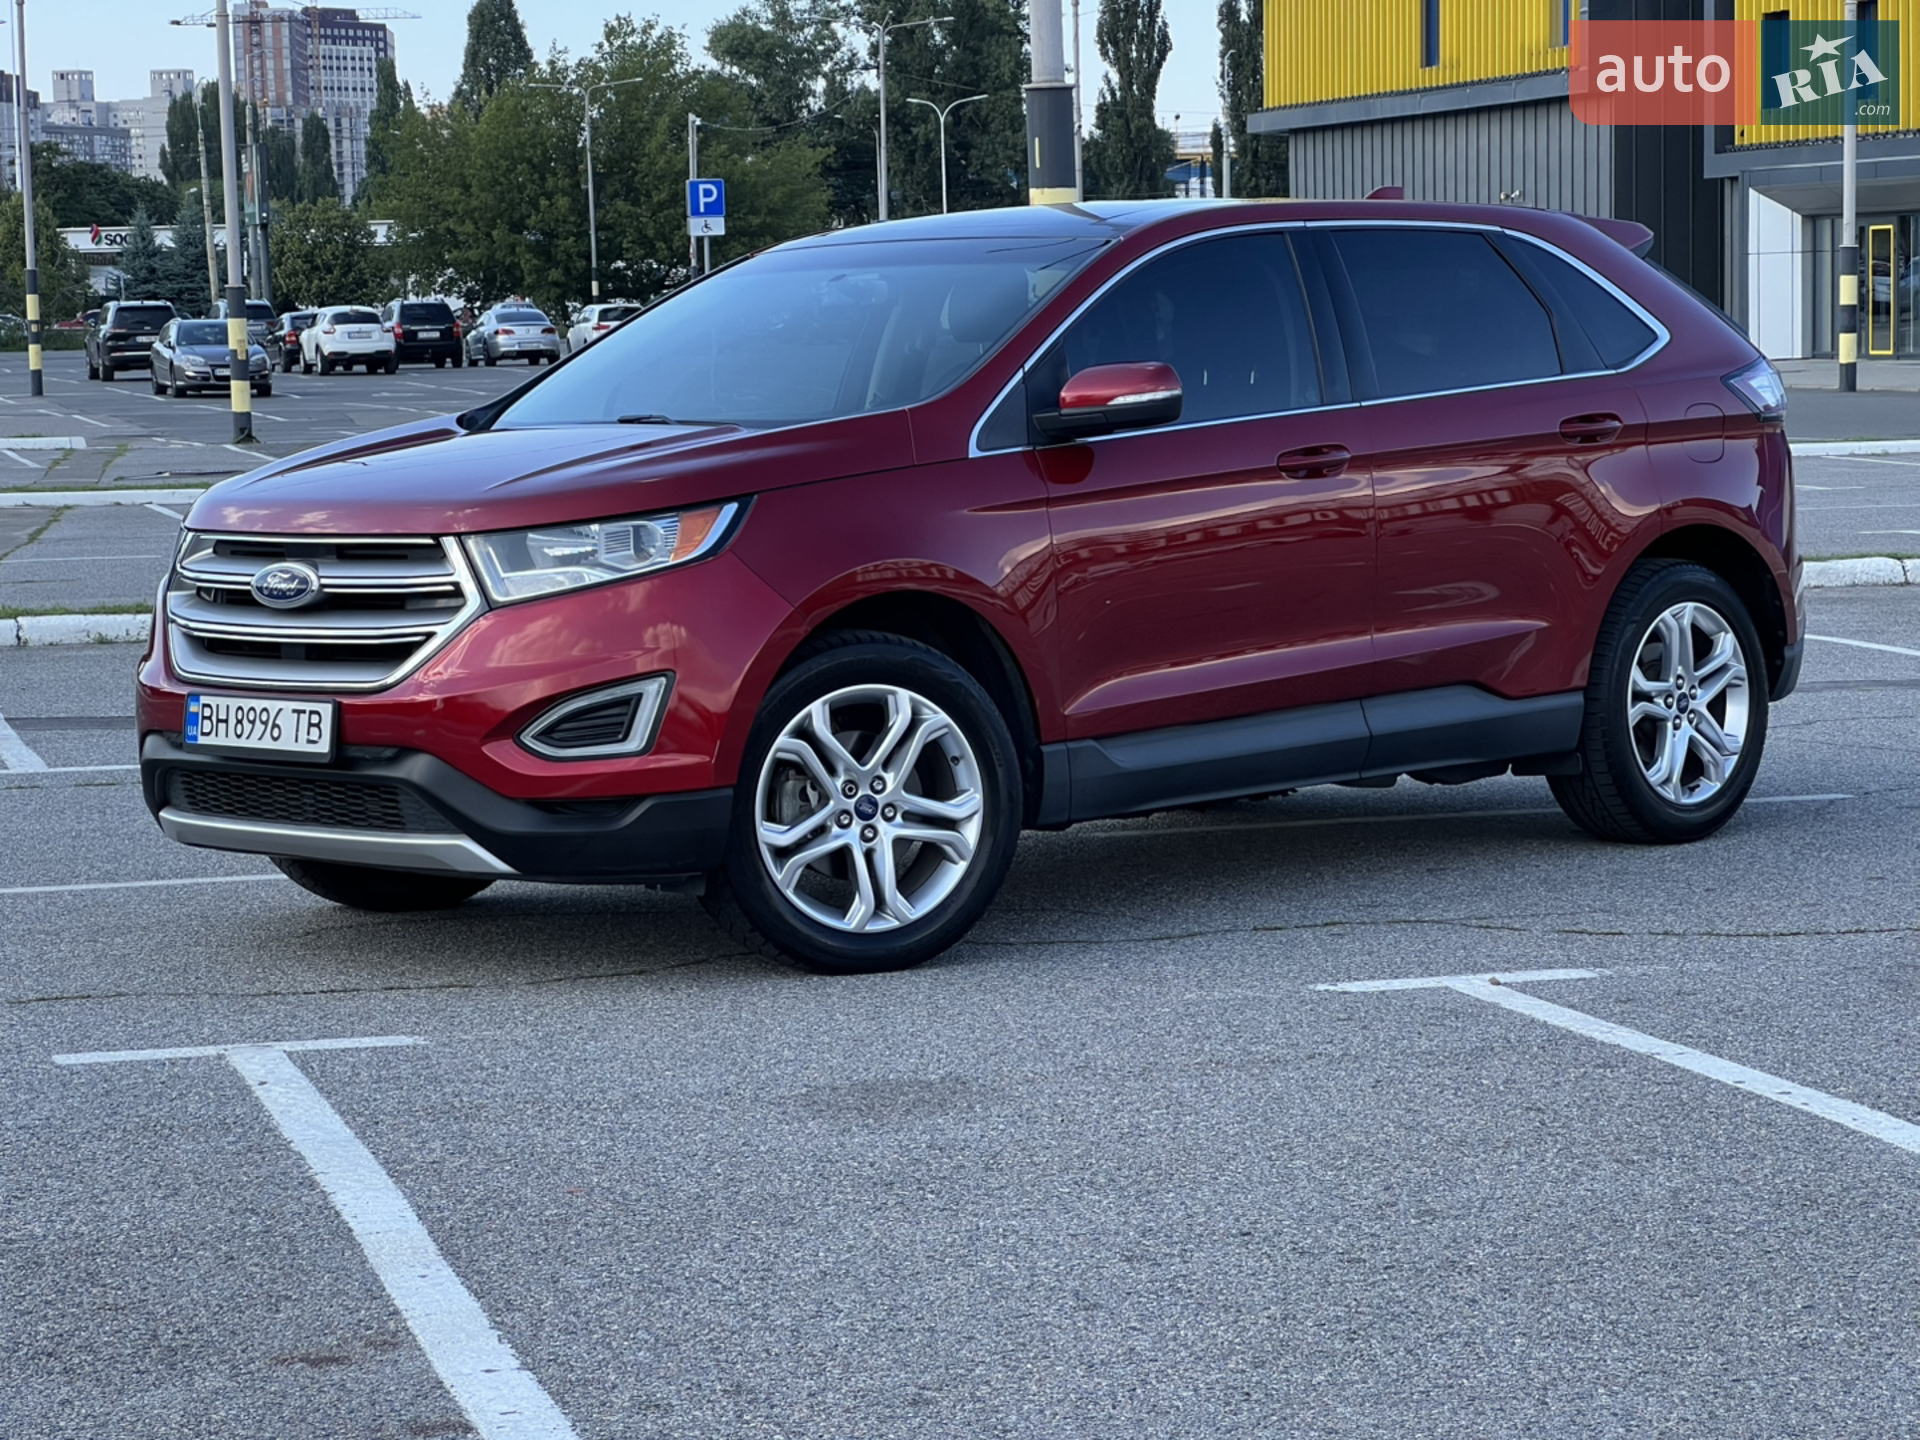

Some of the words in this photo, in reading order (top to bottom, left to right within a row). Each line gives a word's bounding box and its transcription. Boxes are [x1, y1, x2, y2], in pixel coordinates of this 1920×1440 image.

[698, 183, 718, 213] P
[104, 232, 131, 246] SOC
[262, 571, 300, 596] Ford
[187, 724, 198, 736] UA
[199, 703, 230, 738] BH
[234, 704, 284, 743] 8996
[291, 708, 323, 745] TB
